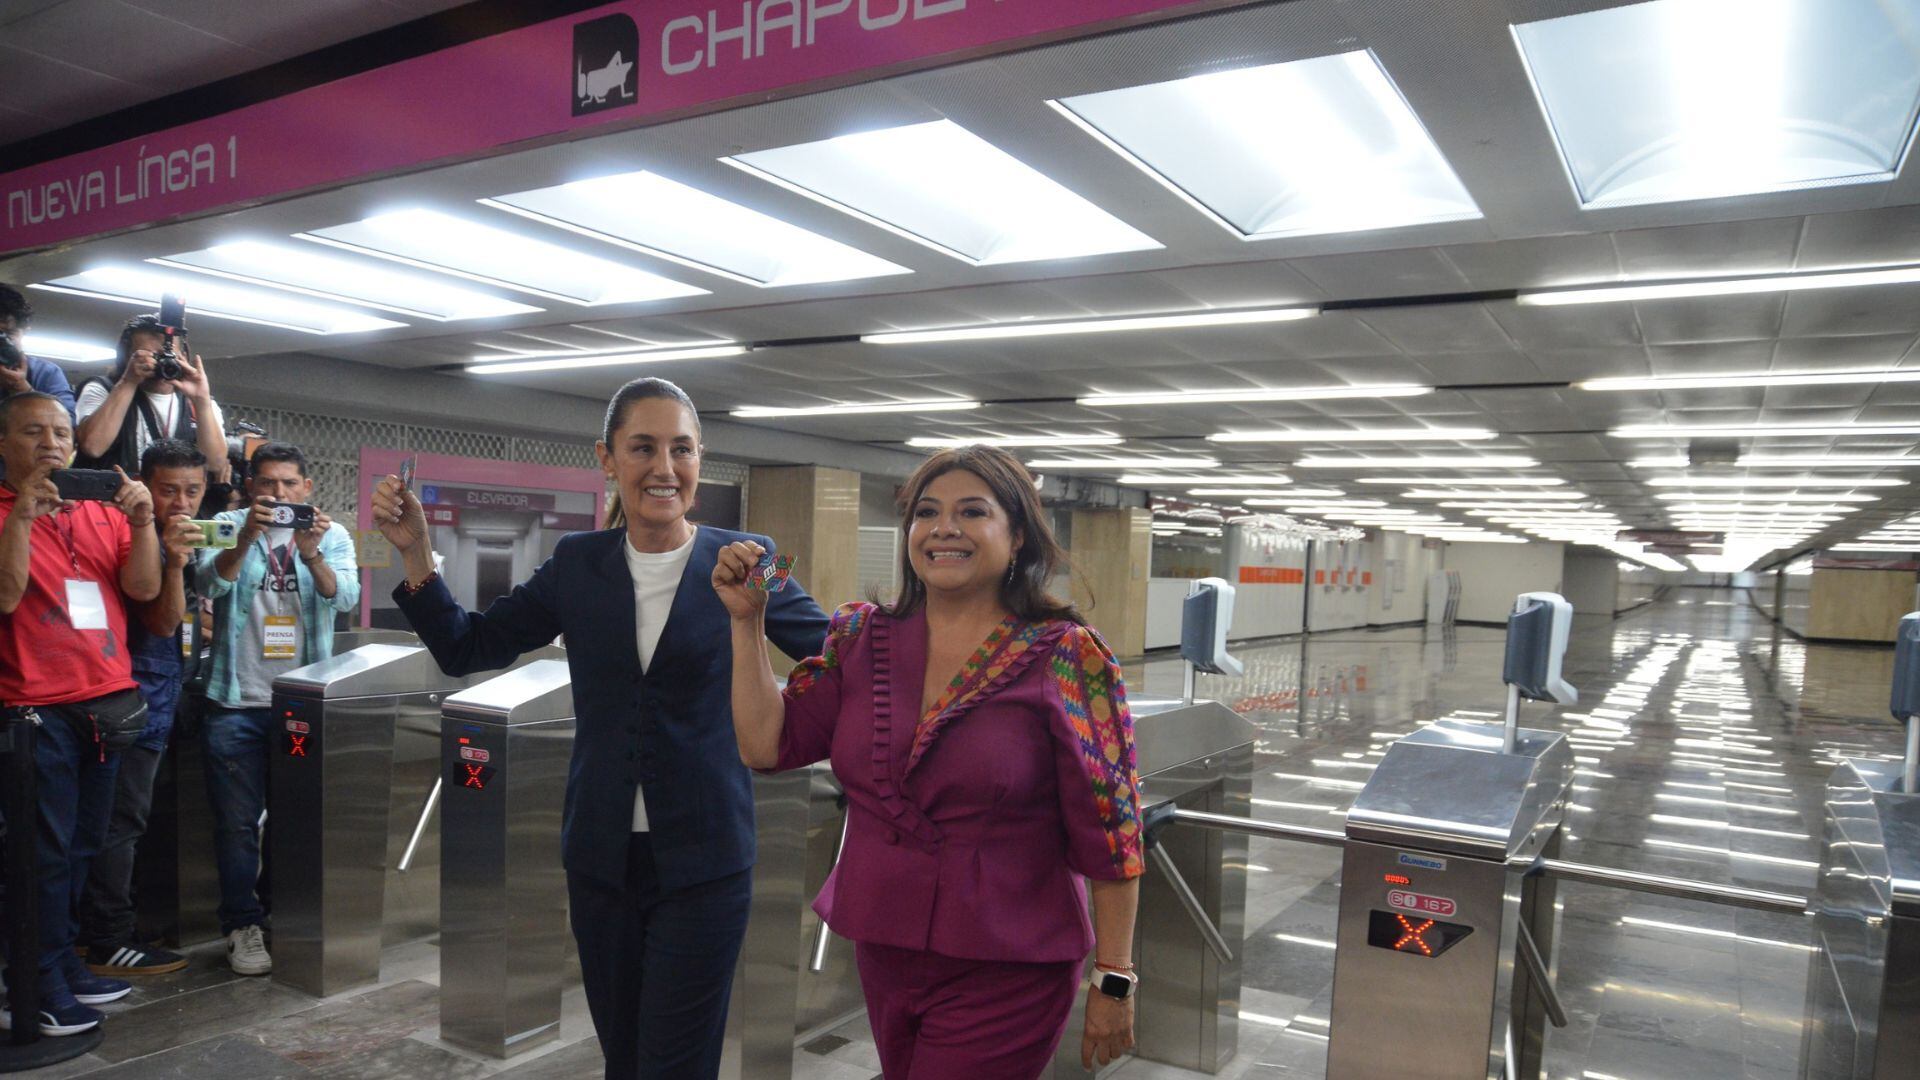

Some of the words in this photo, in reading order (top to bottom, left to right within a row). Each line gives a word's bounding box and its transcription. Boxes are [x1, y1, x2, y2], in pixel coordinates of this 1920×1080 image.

[8, 170, 106, 229] NUEVA
[115, 142, 215, 204] LÍNEA
[227, 135, 236, 178] 1
[467, 491, 529, 506] ELEVADOR
[1423, 899, 1452, 912] 167
